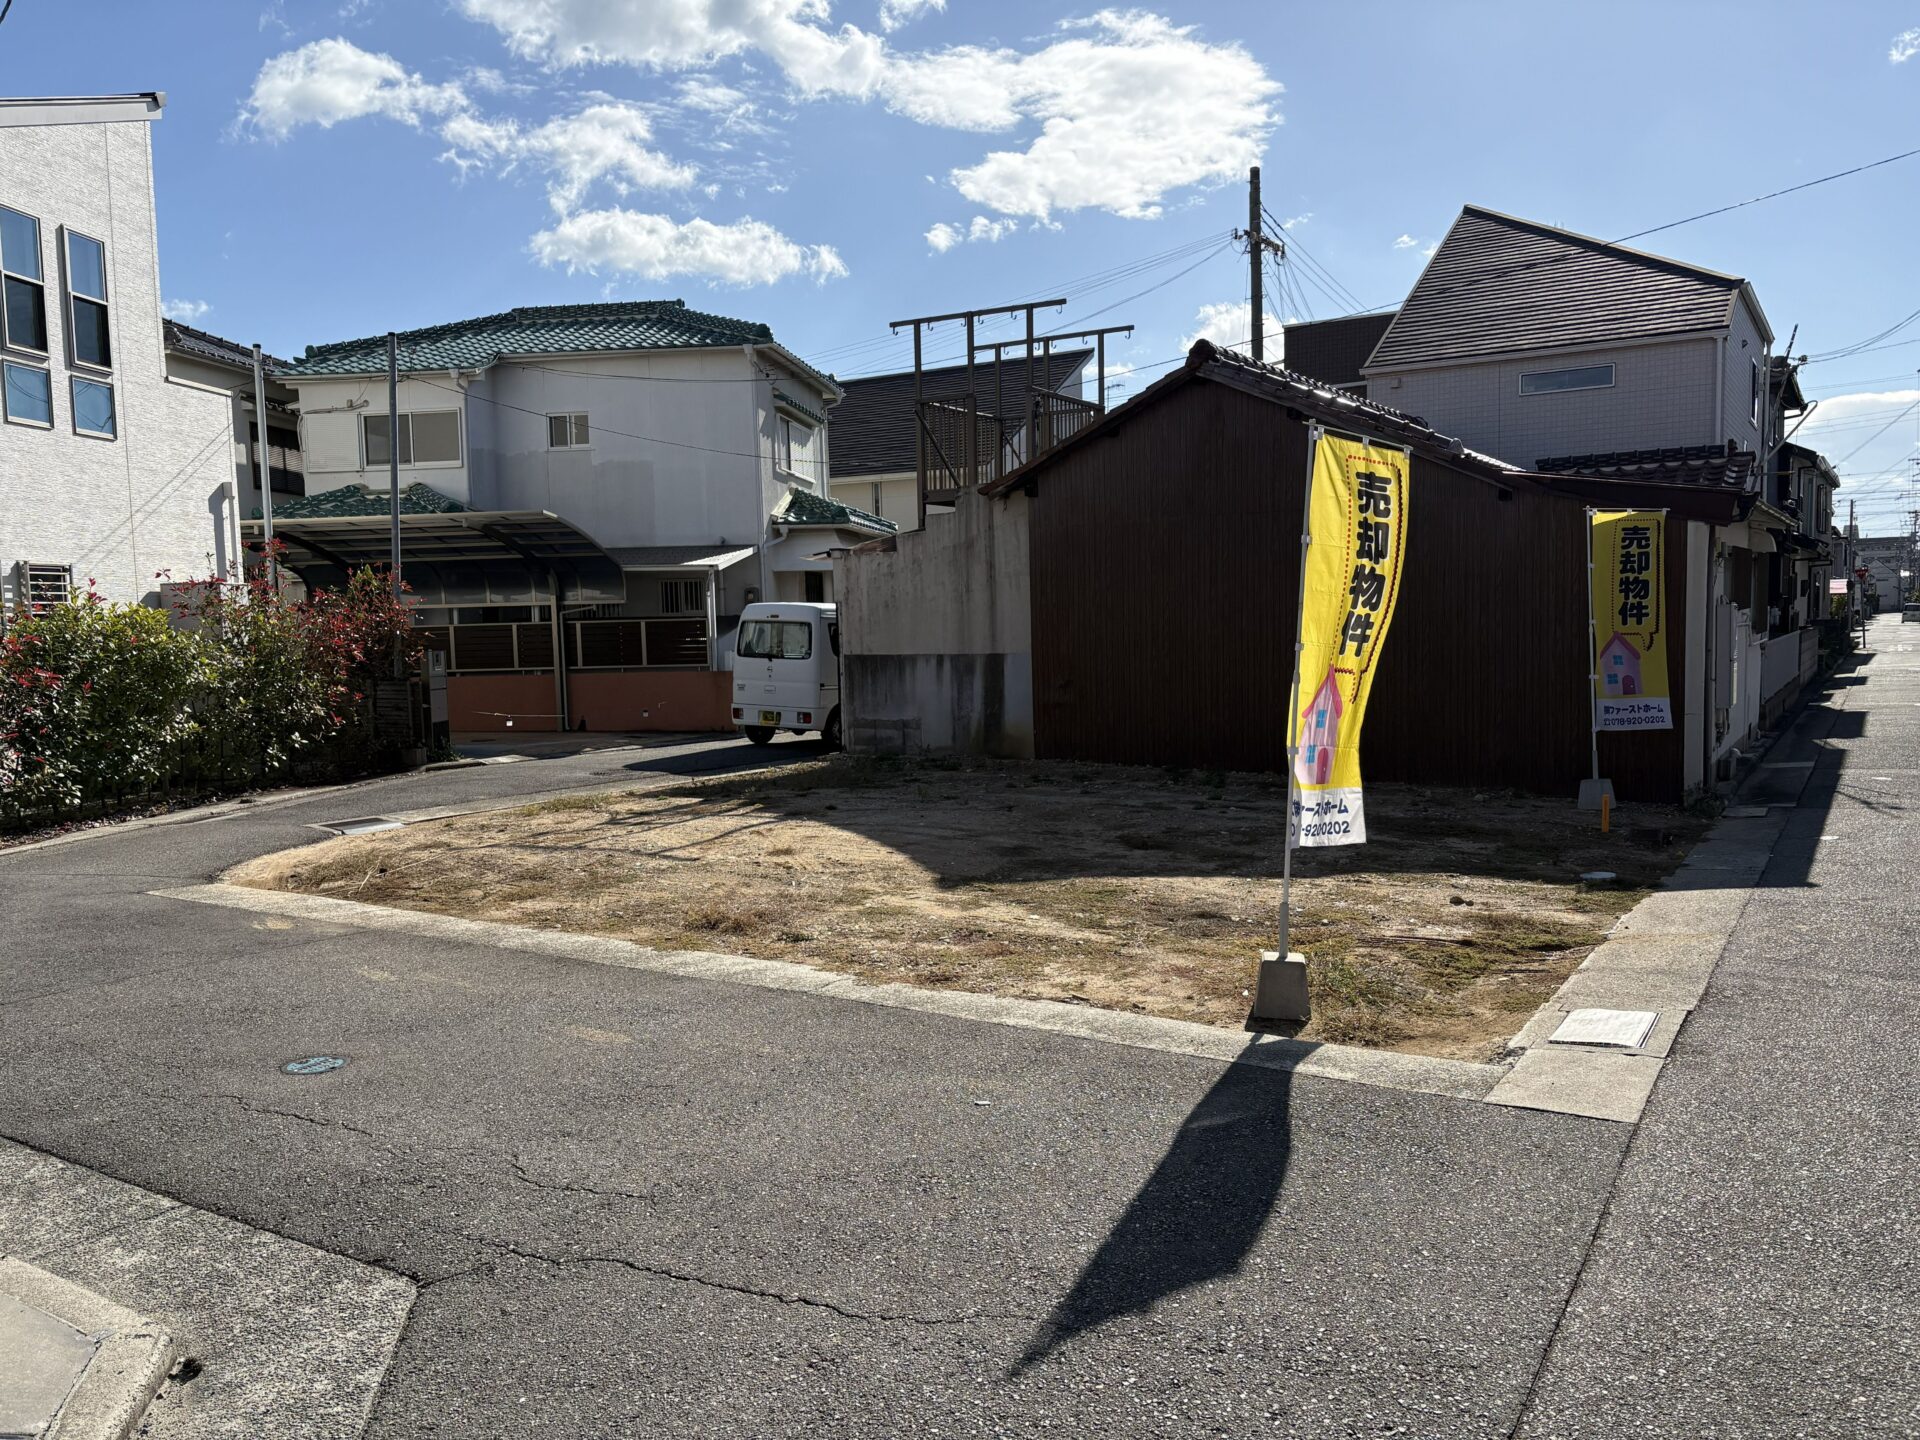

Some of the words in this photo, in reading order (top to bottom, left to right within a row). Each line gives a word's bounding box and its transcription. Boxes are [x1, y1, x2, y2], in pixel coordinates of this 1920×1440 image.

[1339, 471, 1392, 657] 売却物件
[1618, 525, 1651, 626] 売却物件
